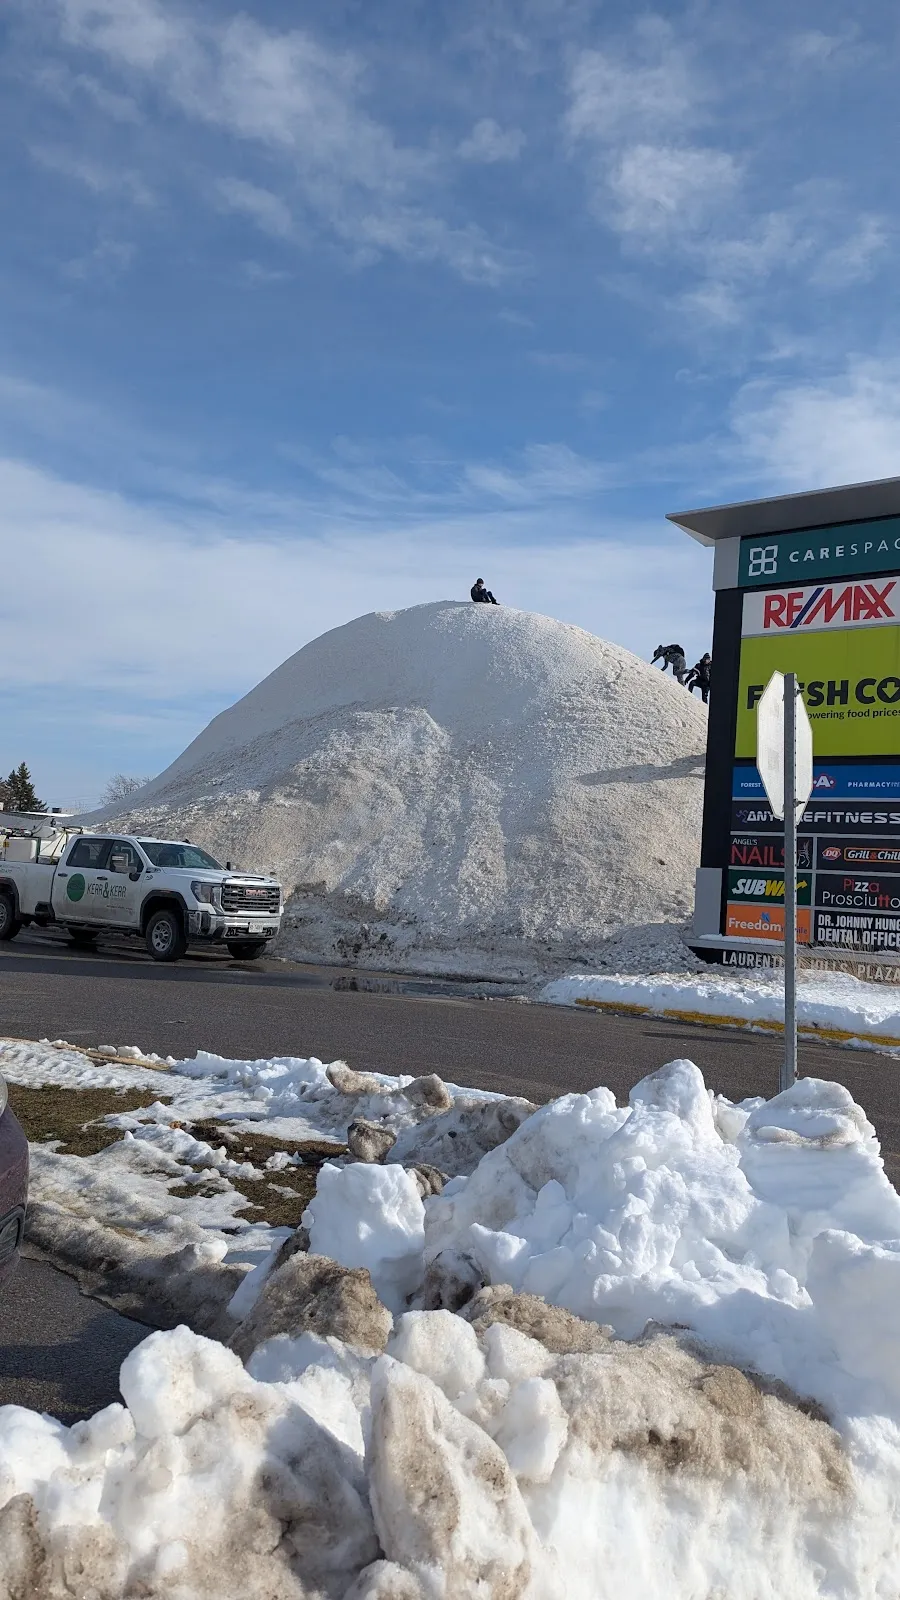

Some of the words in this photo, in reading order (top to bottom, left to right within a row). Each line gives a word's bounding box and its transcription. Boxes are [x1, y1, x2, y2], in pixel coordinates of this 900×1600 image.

[763, 582, 897, 629] RE/MAX
[747, 679, 849, 709] FSH
[808, 710, 844, 720] owering
[847, 708, 870, 718] food
[732, 837, 758, 846] ANGEL'S
[843, 878, 880, 893] Pizza
[822, 890, 900, 909] Prosciutto
[728, 917, 782, 932] Freedom
[818, 914, 834, 927] DR.
[836, 915, 873, 930] JOHNNY
[817, 927, 860, 944] DENTAL
